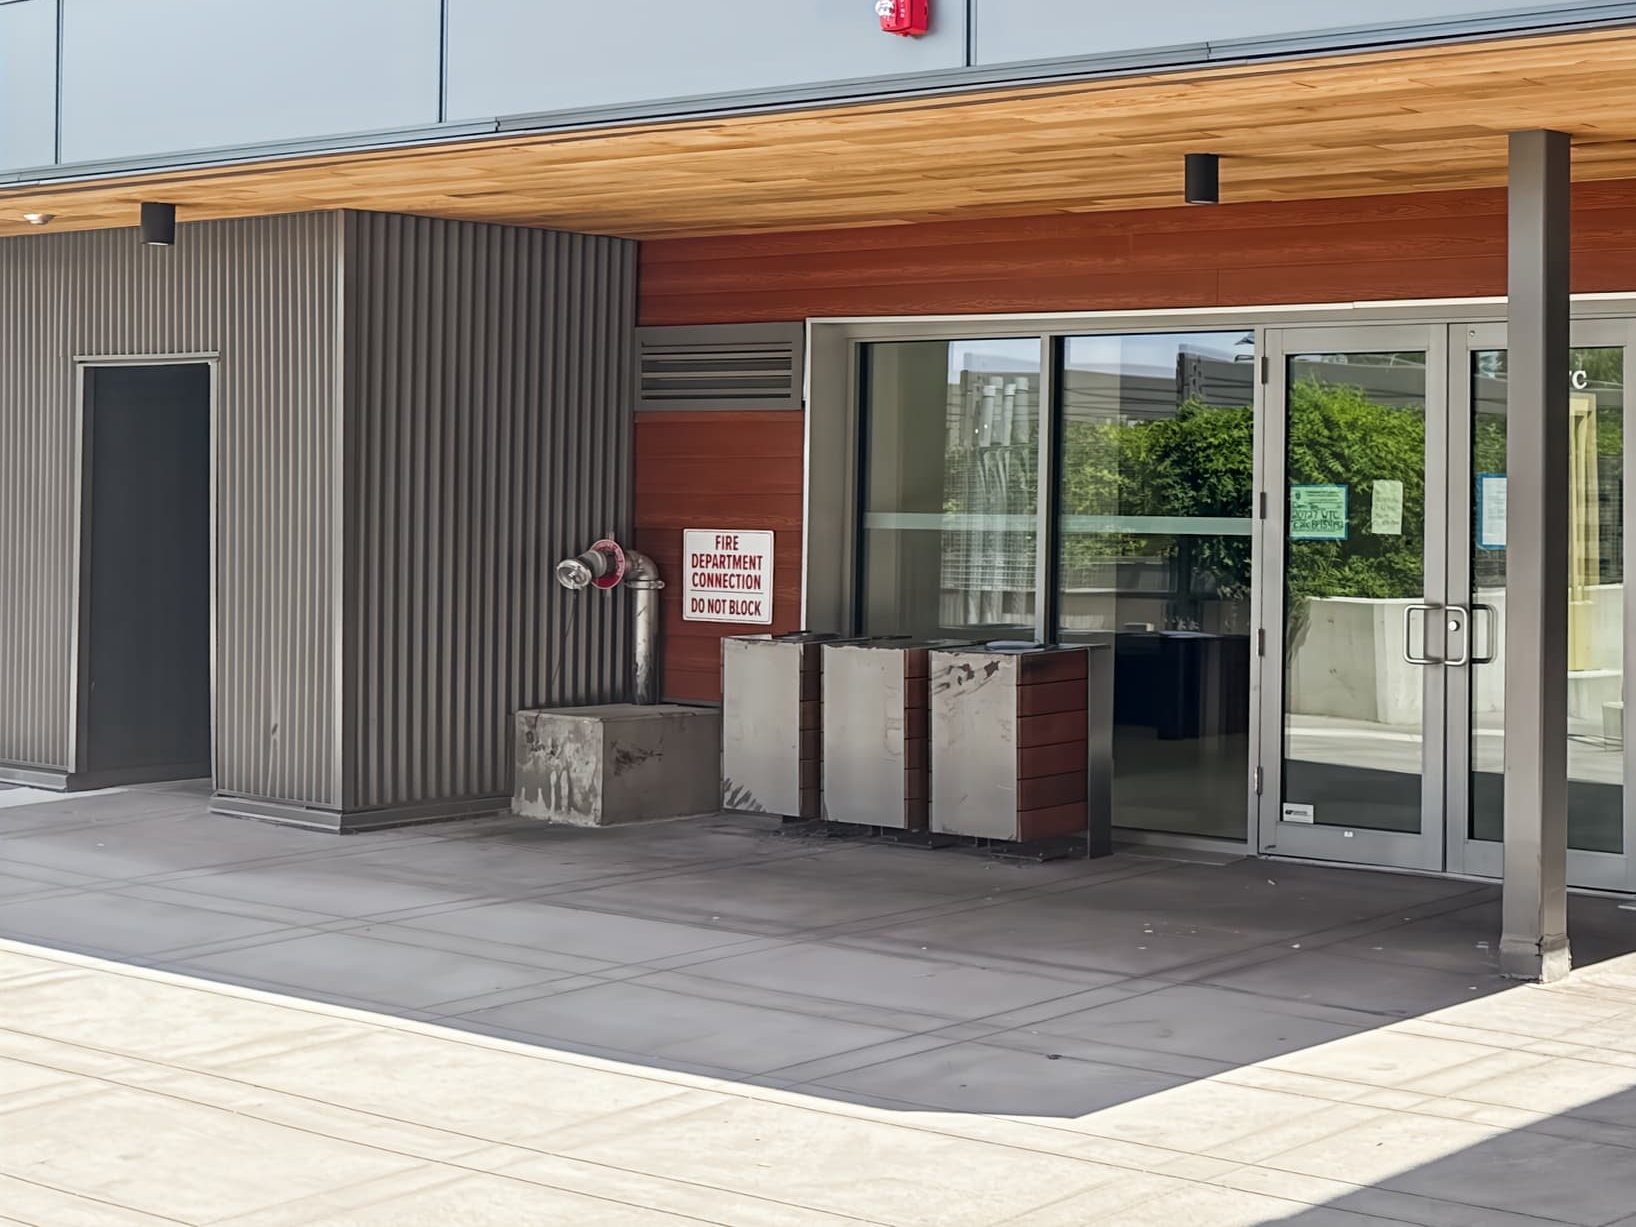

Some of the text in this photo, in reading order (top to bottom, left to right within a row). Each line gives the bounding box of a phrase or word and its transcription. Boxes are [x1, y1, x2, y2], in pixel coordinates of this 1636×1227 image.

[1569, 370, 1587, 390] C
[715, 535, 739, 551] FIRE
[691, 553, 763, 571] DEPARTMENT
[692, 572, 761, 590] CONNECTION
[691, 597, 762, 616] DO NOT BLOCK
